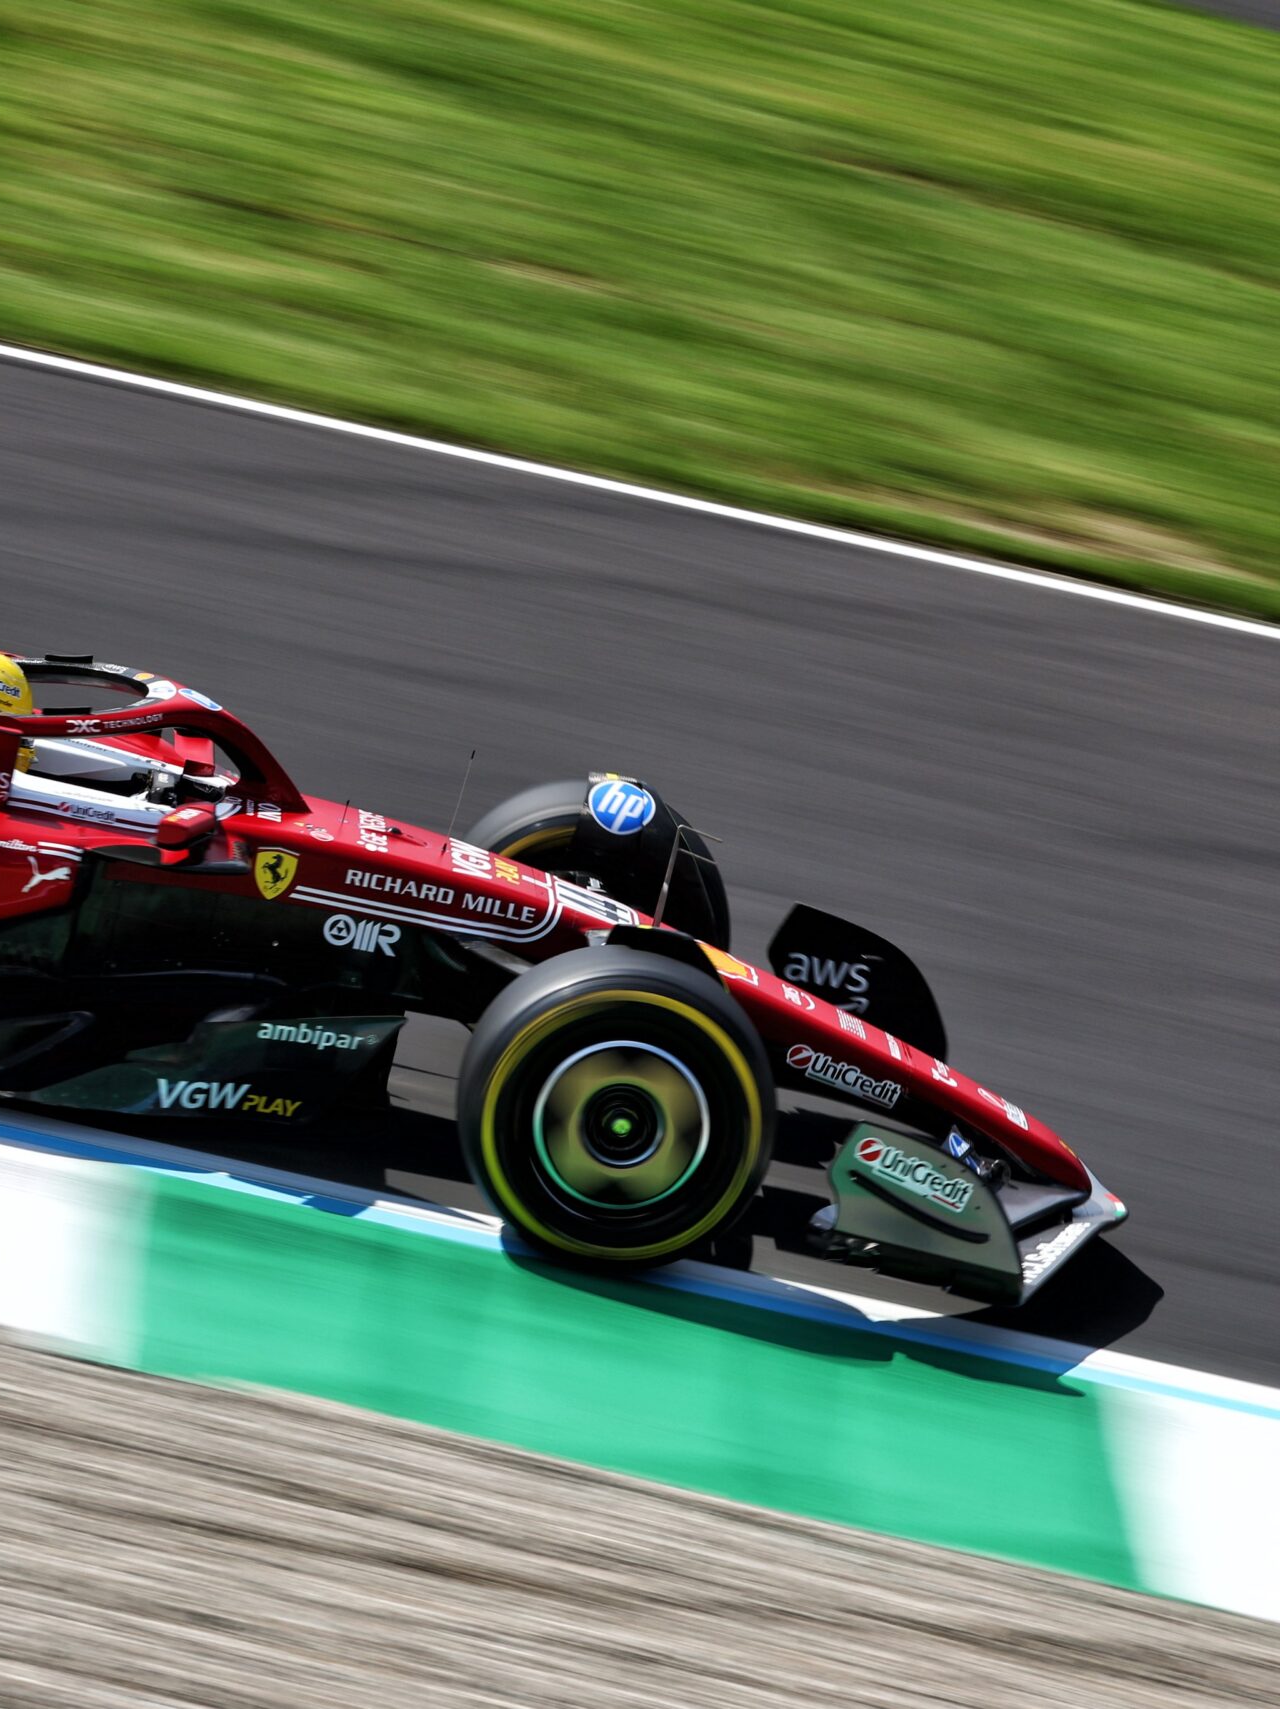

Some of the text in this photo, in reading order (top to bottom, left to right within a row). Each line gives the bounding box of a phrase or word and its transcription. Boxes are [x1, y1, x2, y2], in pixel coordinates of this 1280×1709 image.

[103, 713, 163, 729] TECHNOLOGY
[71, 804, 117, 822] UniCredit
[597, 782, 648, 832] hp
[345, 869, 536, 923] RICHARD MILLE
[783, 952, 871, 993] aws
[257, 1022, 363, 1050] ambipar
[157, 1079, 302, 1117] VGW PLAY
[811, 1053, 901, 1103] UniCredit
[881, 1148, 971, 1205] UniCredit
